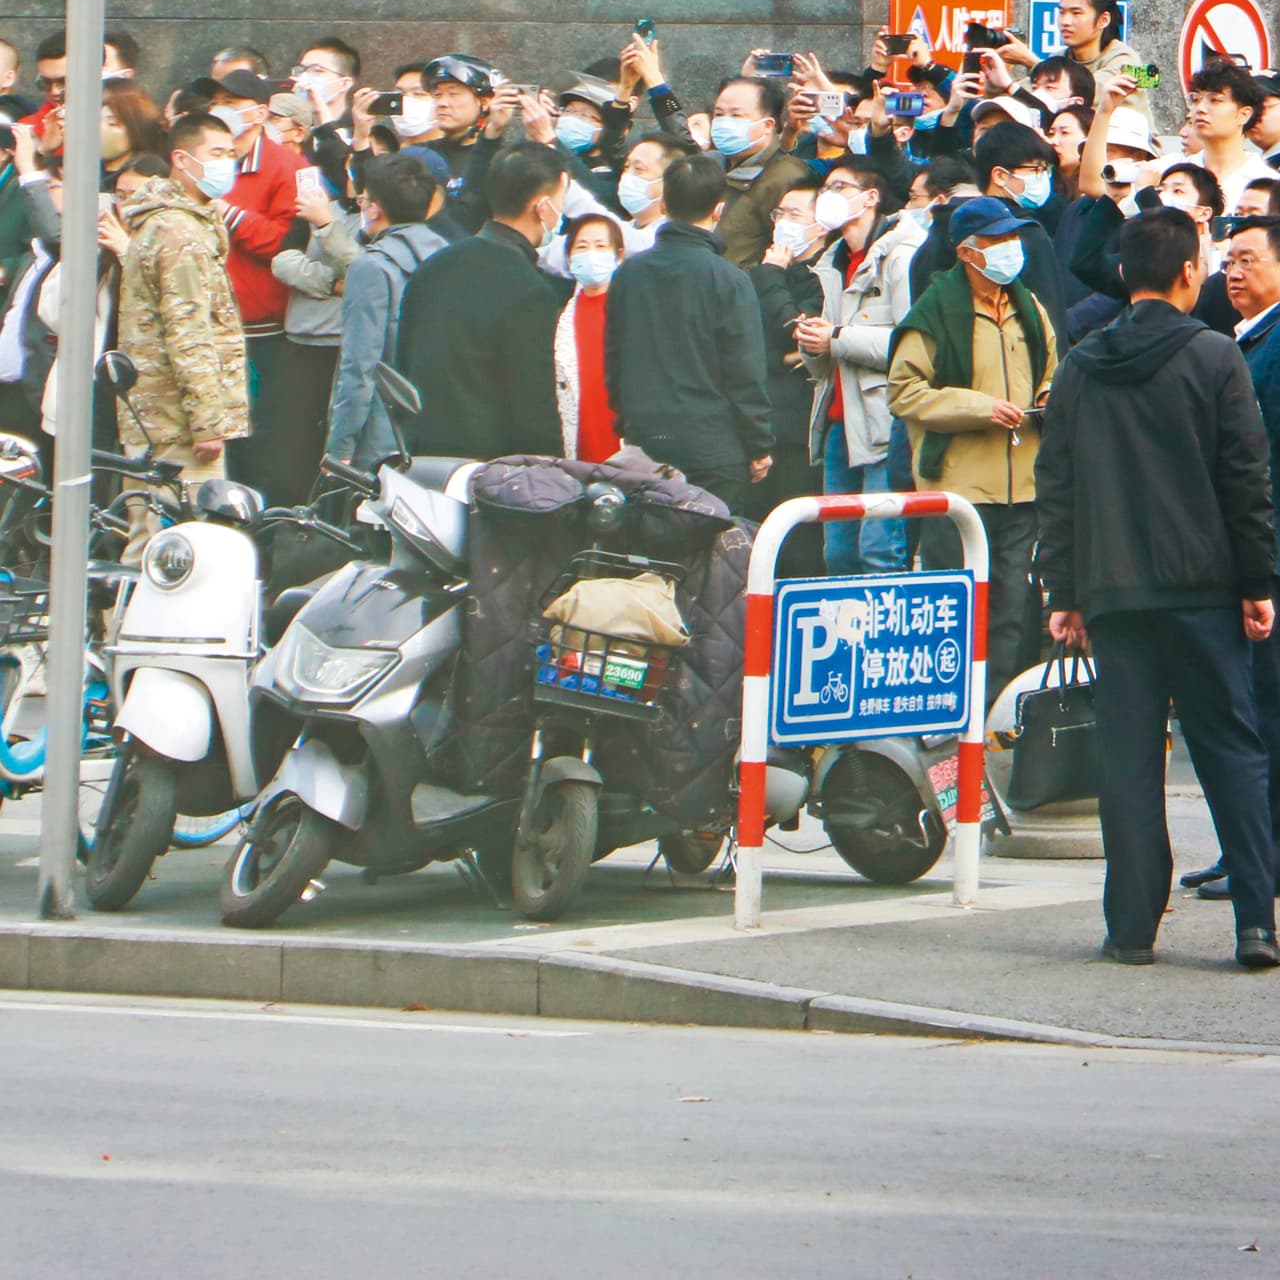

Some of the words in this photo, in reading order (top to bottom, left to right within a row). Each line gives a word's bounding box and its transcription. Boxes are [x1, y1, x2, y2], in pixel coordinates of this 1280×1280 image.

[862, 594, 958, 639] 非机动车
[793, 616, 839, 706] P
[861, 644, 933, 689] 停放处
